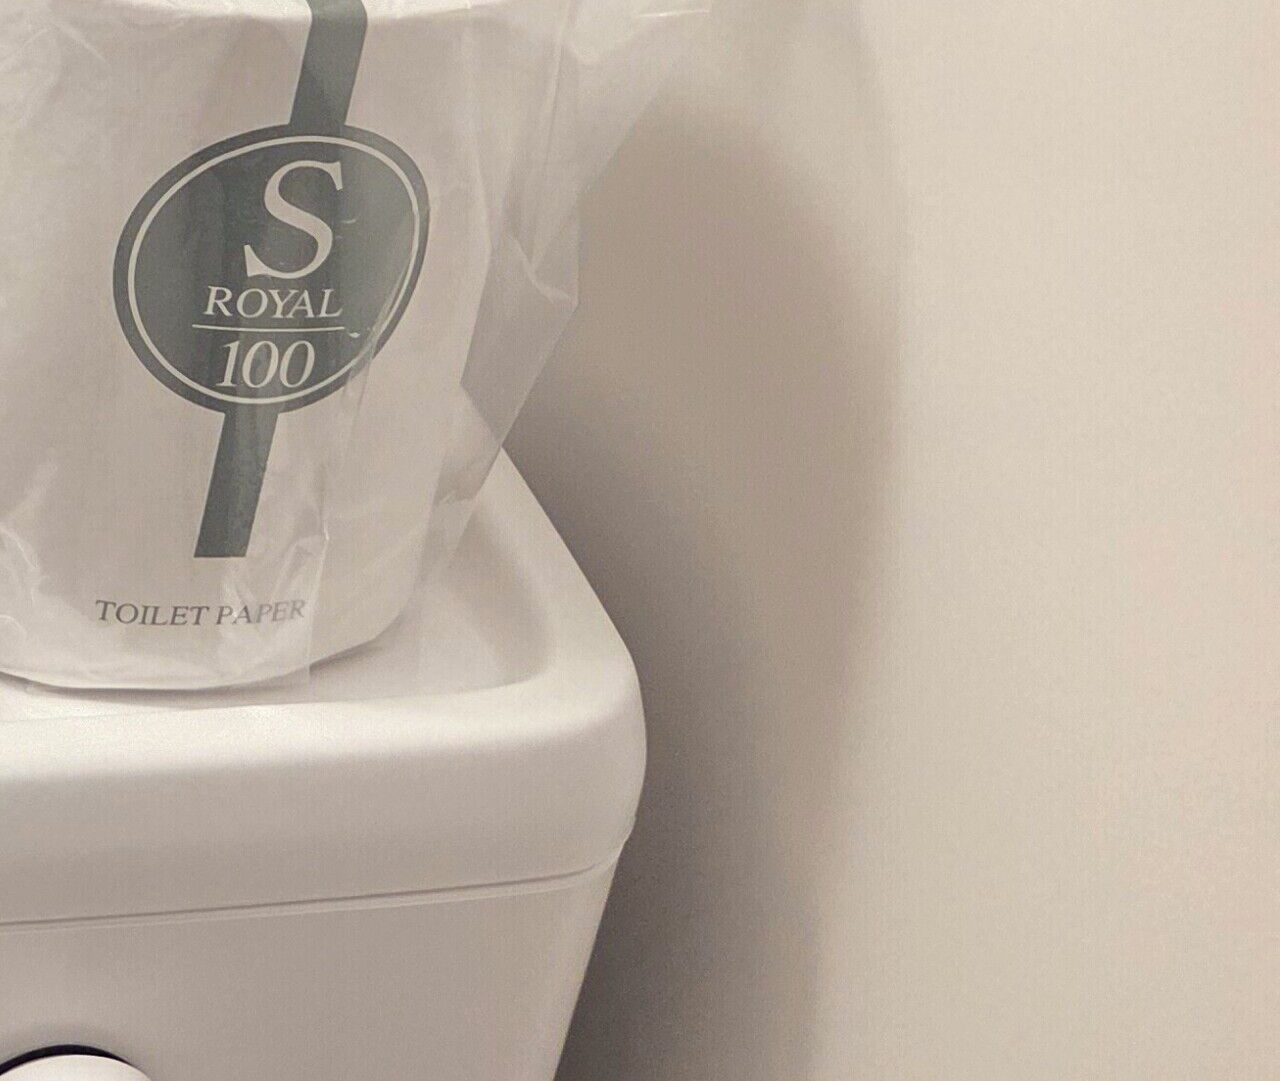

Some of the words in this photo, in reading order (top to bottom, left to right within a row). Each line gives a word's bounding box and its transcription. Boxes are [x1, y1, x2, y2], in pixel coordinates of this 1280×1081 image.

[244, 160, 344, 279] S
[203, 286, 344, 319] ROYAL
[216, 340, 315, 388] 100
[95, 600, 209, 626] TOILET
[214, 599, 306, 626] PAPER
